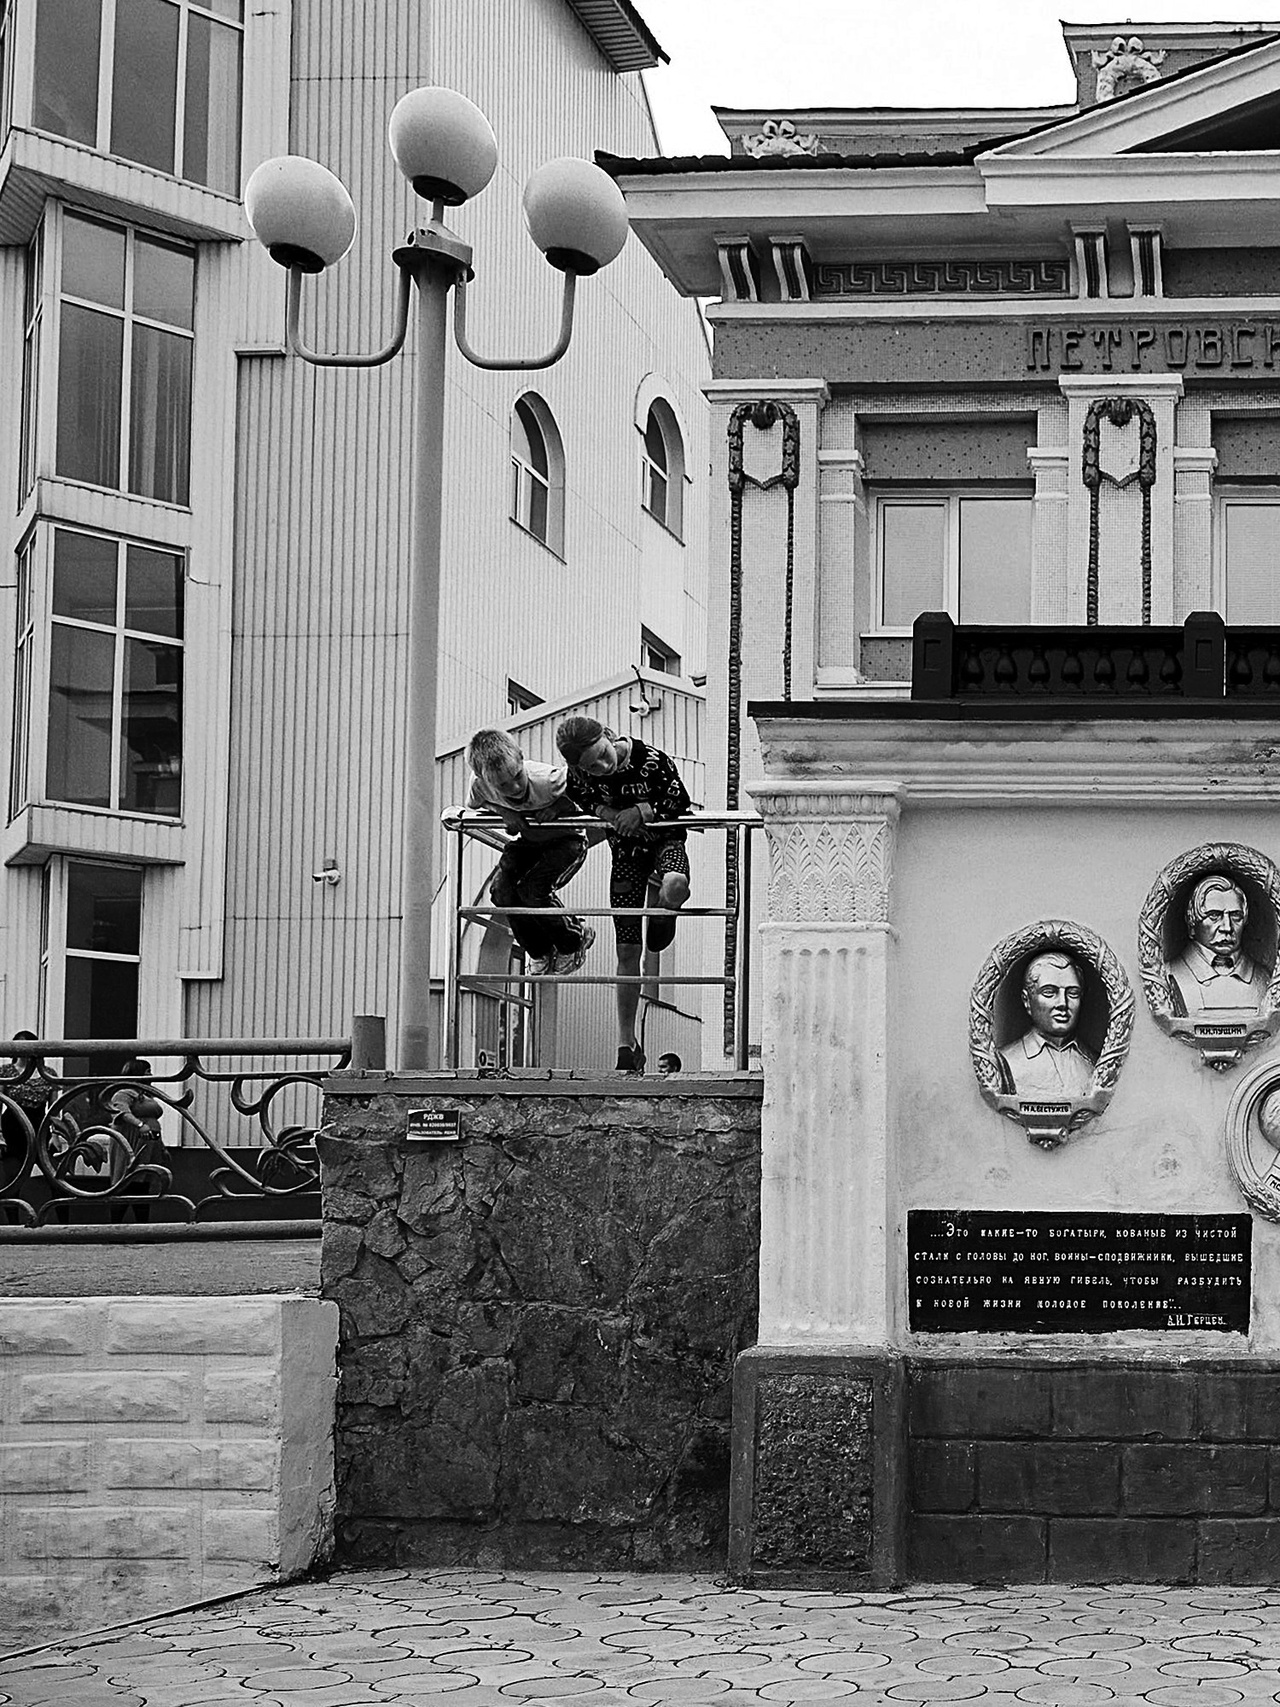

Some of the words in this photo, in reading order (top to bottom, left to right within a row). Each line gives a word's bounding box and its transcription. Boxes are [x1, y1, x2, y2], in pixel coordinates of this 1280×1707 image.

[1116, 1228, 1166, 1238] КОВАНЫЕ
[1175, 1229, 1188, 1239] ИЗ
[1195, 1226, 1237, 1239] ЧИСТОЙ
[914, 1251, 949, 1261] СТАЛИ
[967, 1252, 1007, 1261] ГОЛОВЫ
[1012, 1252, 1024, 1262] ДО
[1184, 1253, 1244, 1263] ВЫШЕДШИЕ
[915, 1275, 992, 1285] СОЗНАТЕЛЬНО
[1002, 1275, 1014, 1284] НА
[1024, 1276, 1061, 1285] ЯВНУЮ
[1123, 1276, 1159, 1286] ЧТОБЫ
[1177, 1276, 1242, 1286] РАЗБУДИТЬ
[933, 1296, 970, 1309] НОВОЙ
[983, 1299, 1022, 1308] ЖИЗНИ
[1036, 1299, 1086, 1309] МОЛОДОЕ
